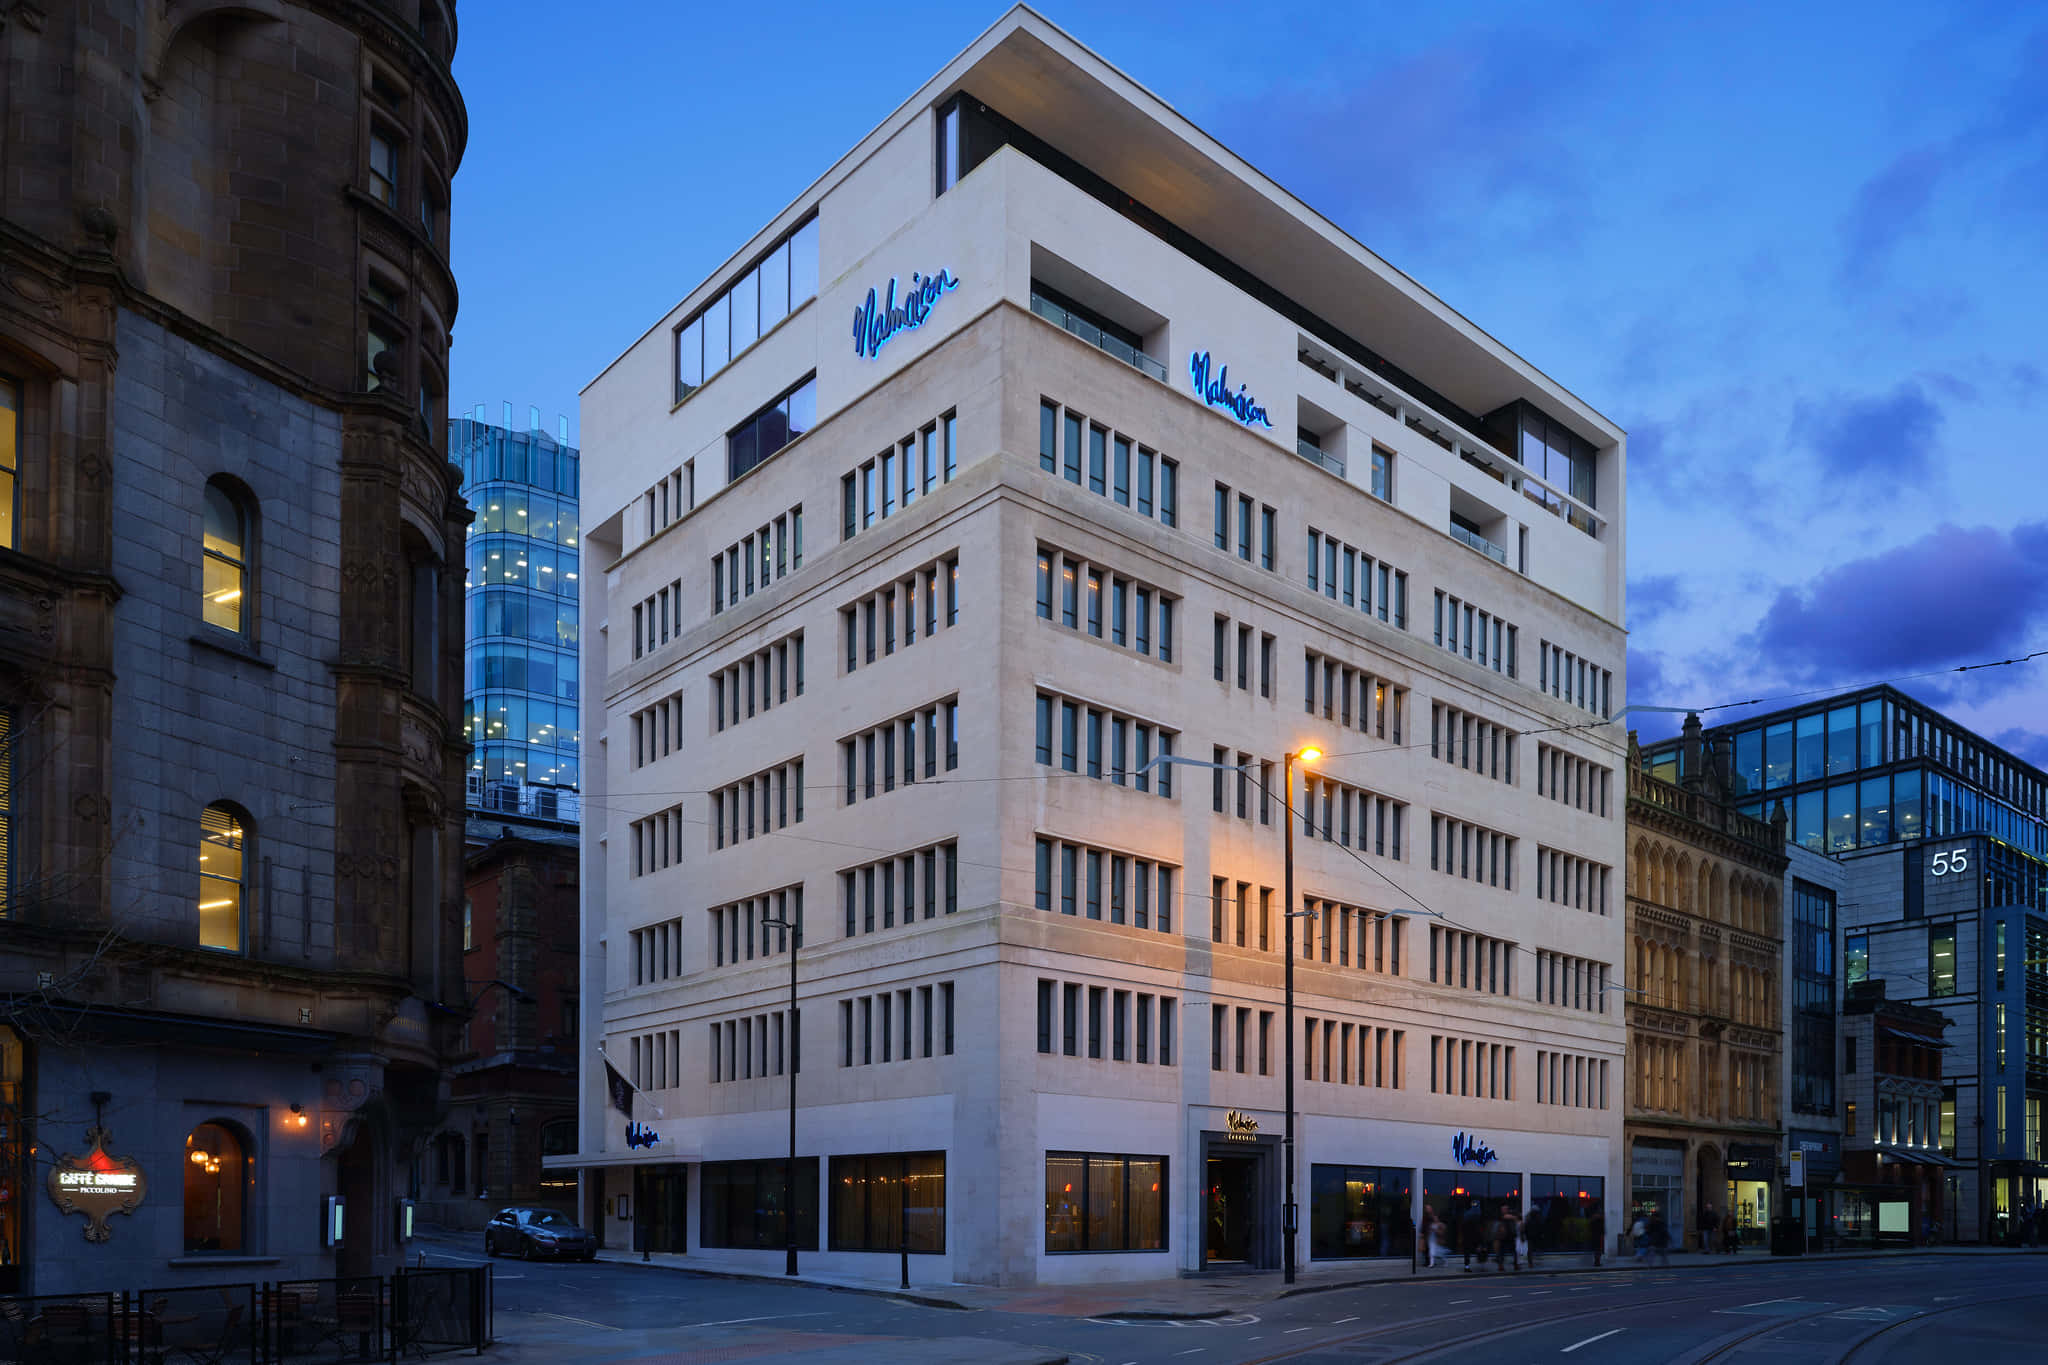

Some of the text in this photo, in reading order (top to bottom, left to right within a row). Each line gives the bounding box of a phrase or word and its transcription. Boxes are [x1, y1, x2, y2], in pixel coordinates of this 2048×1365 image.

[852, 268, 959, 360] Malmaison
[1190, 351, 1273, 429] Malmaison
[1931, 848, 1967, 876] 55
